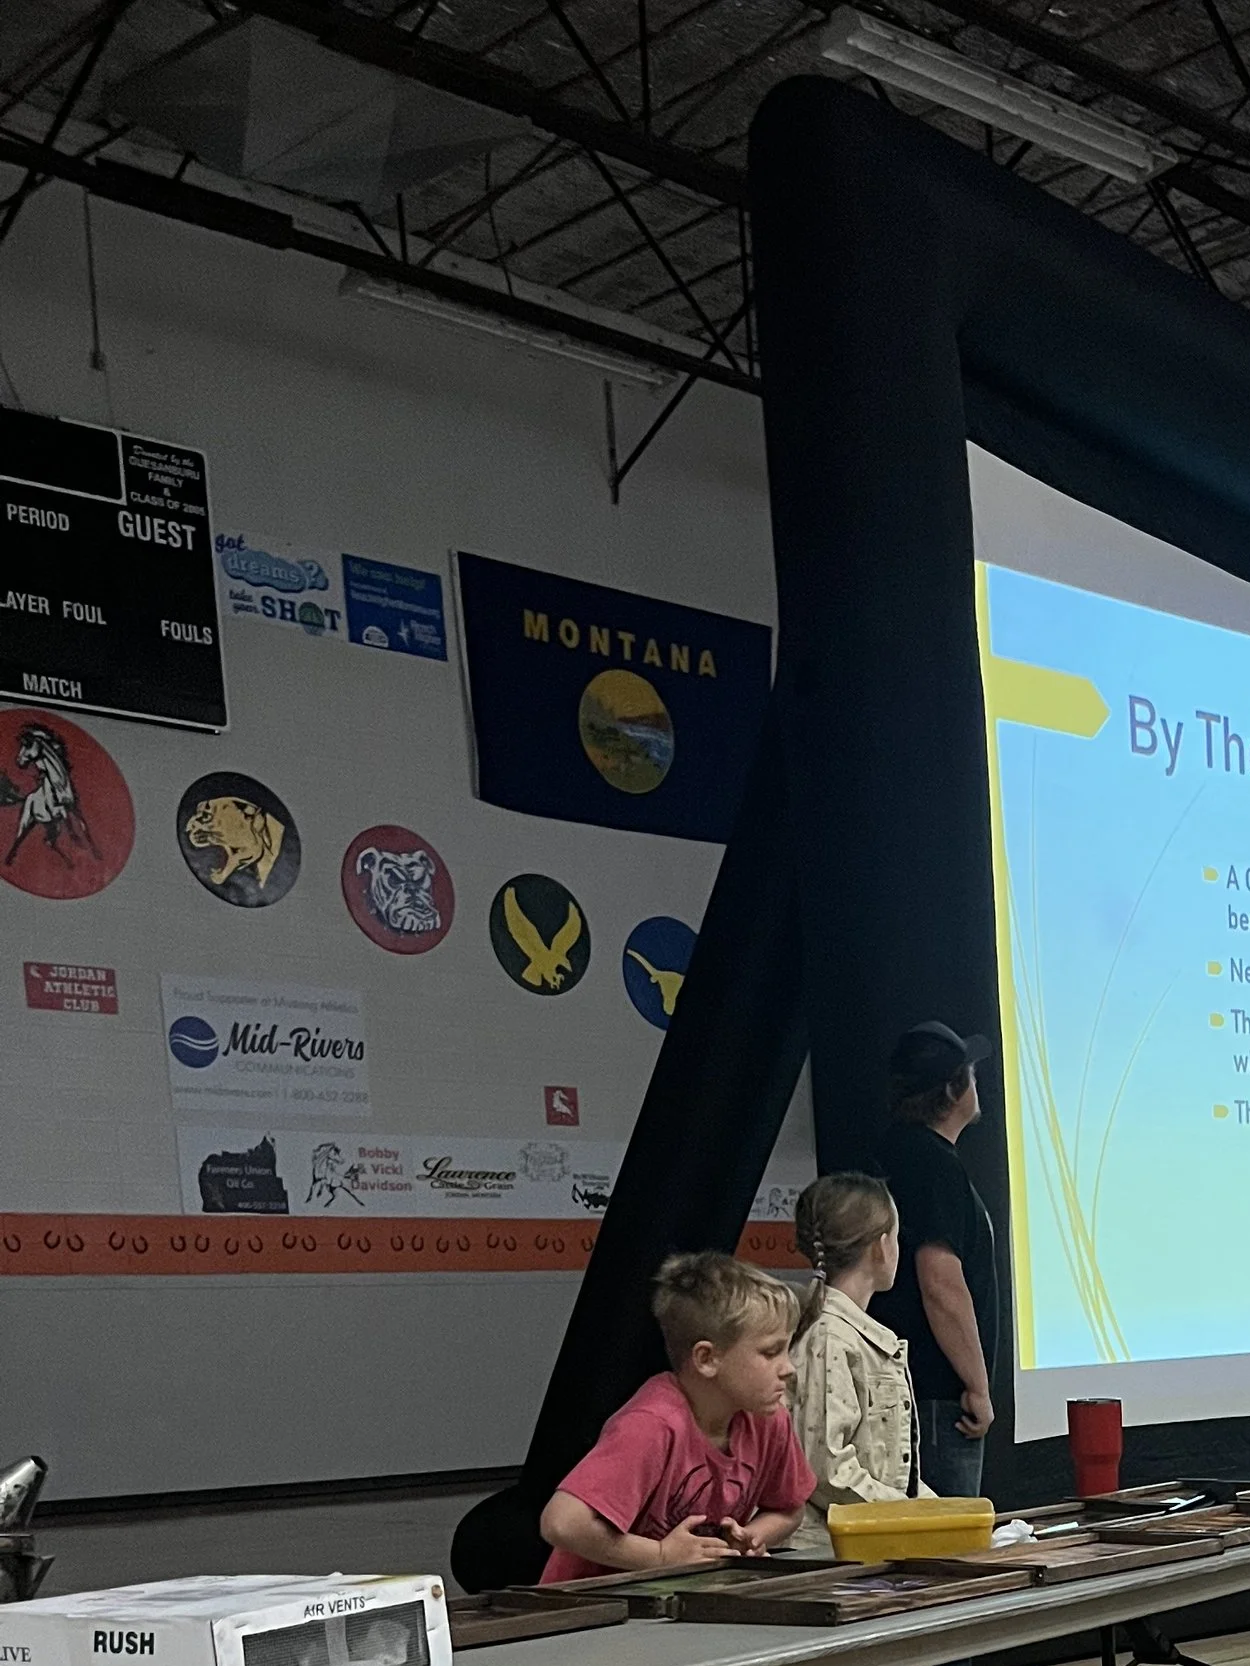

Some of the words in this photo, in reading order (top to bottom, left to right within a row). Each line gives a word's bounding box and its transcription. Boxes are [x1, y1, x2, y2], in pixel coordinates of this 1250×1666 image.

[130, 491, 165, 507] CLASS
[166, 499, 181, 510] OF
[6, 503, 70, 532] PERIOD
[117, 509, 196, 551] GUEST
[215, 533, 248, 553] got
[62, 600, 107, 625] FOUL
[160, 619, 214, 645] FOULS
[522, 608, 718, 679] MONTANA
[22, 672, 83, 700] MATCH
[1128, 693, 1184, 777] By
[1226, 863, 1240, 891] A
[49, 965, 107, 982] JORDAN
[43, 981, 116, 998] ATHLETIC
[63, 998, 100, 1012] CLUB
[222, 1021, 365, 1062] Mid-Rivers
[235, 1061, 355, 1080] COMMUNICATIONS
[358, 1146, 399, 1161] Bobby
[244, 1165, 272, 1175] Union
[370, 1163, 403, 1175] Vicki
[416, 1156, 516, 1182] Lawrence
[350, 1179, 412, 1192] Davidson
[304, 1602, 325, 1618] AIR
[328, 1595, 366, 1614] VENTS
[93, 1630, 155, 1656] RUSH
